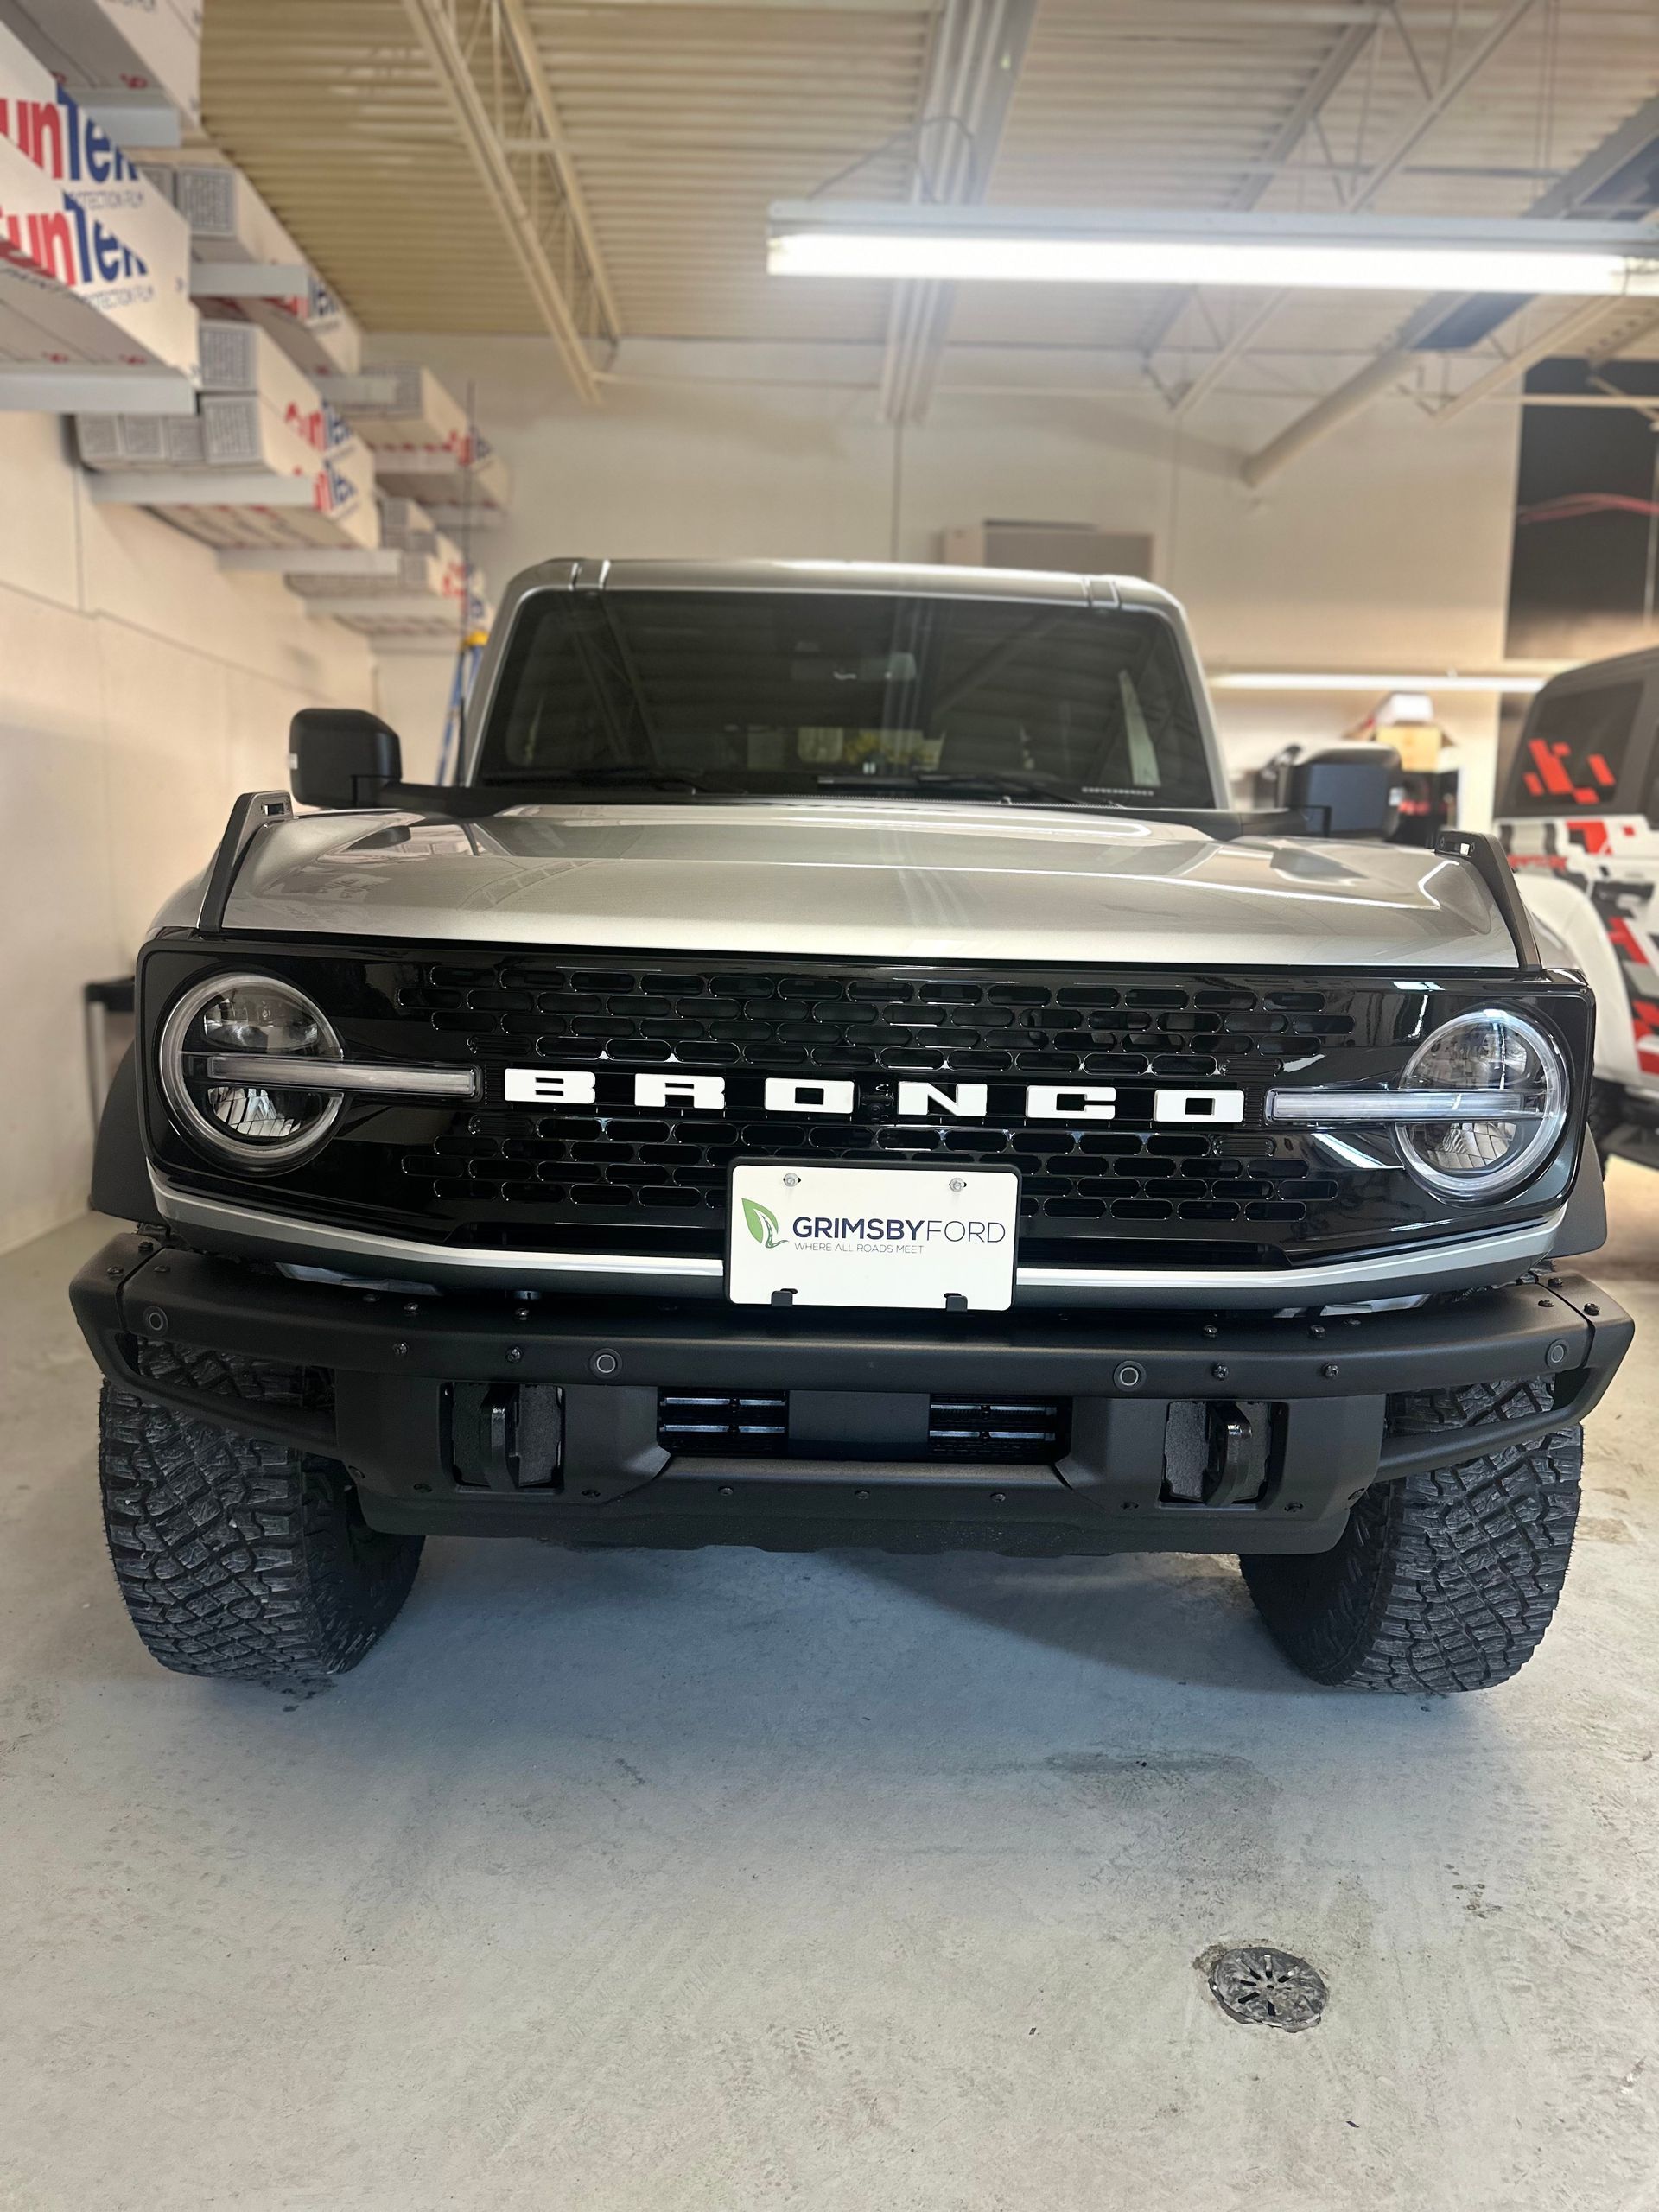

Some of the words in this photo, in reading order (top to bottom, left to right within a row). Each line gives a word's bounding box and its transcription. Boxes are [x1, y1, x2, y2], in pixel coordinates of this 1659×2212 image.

[505, 1068, 1244, 1123] BRONCO
[792, 1216, 1006, 1243] GRIMSBYFORD
[794, 1242, 832, 1252] WHERE
[834, 1243, 854, 1252] ALL
[856, 1243, 893, 1254] ROADS
[896, 1244, 924, 1254] MEET
